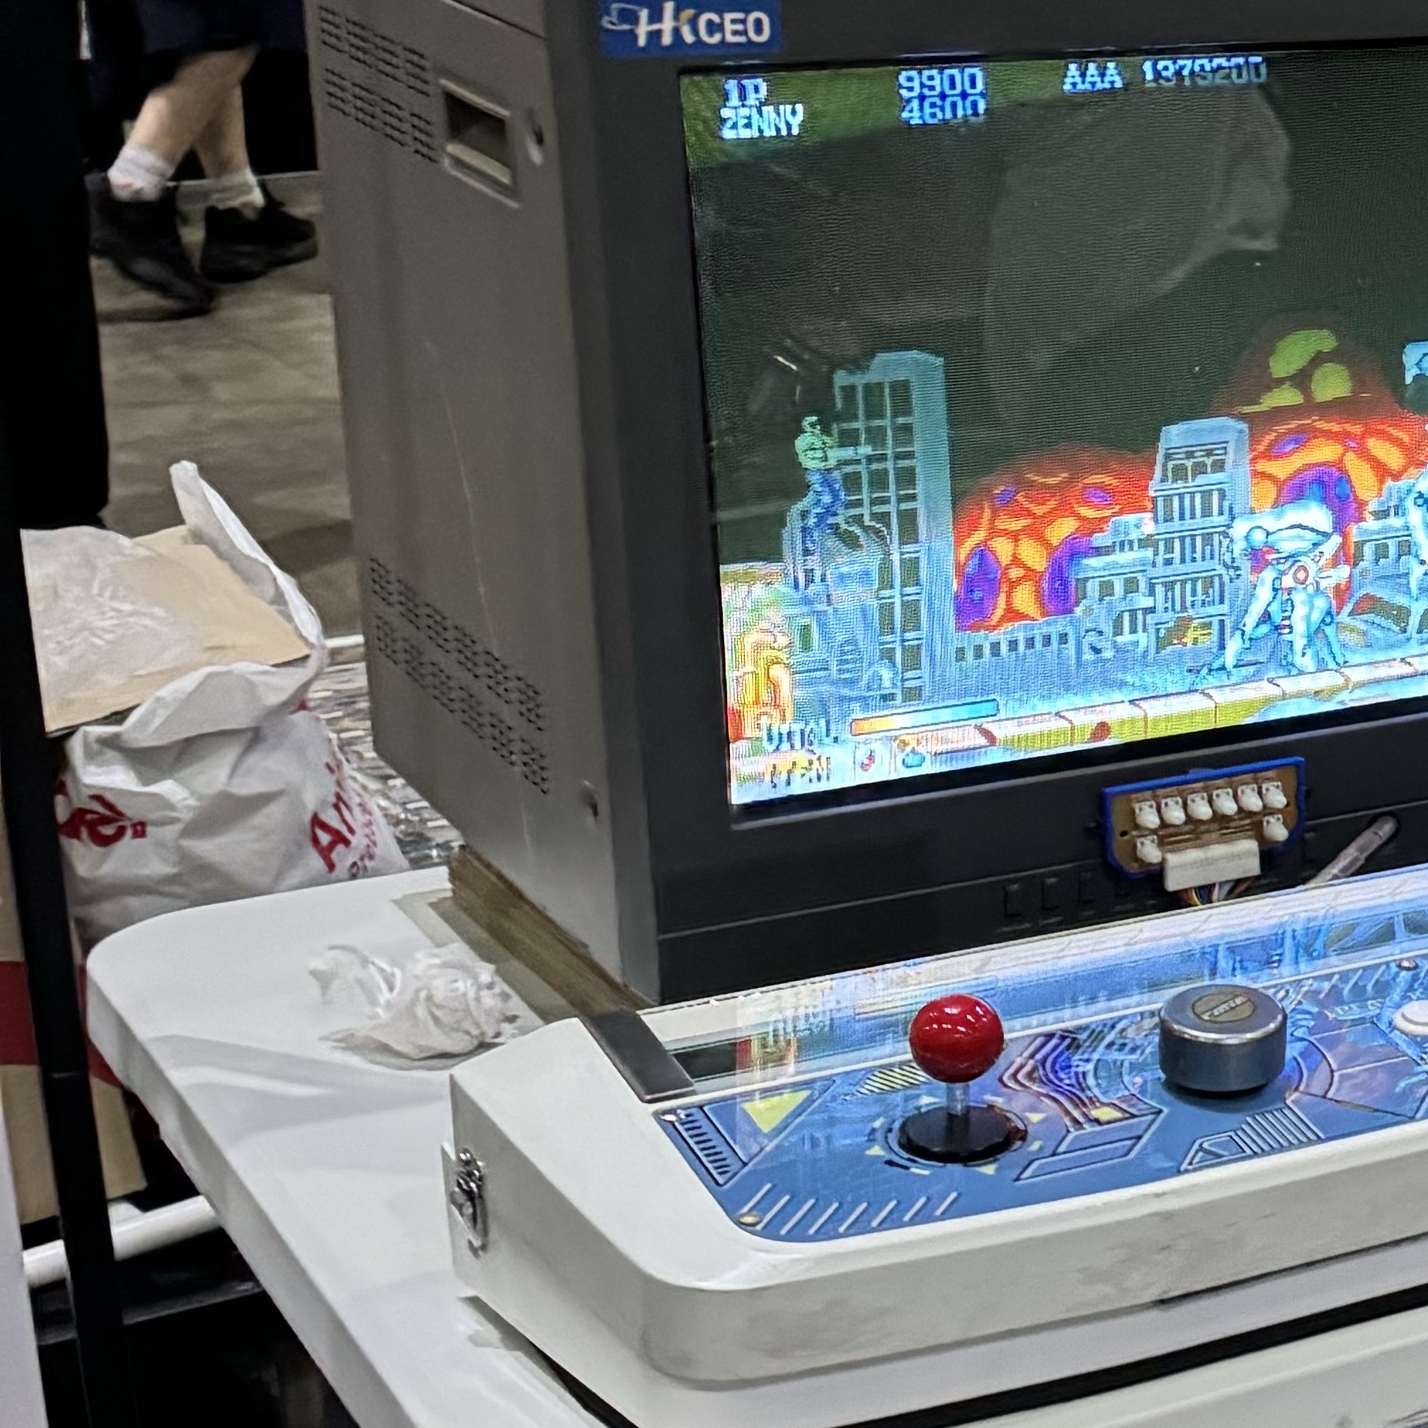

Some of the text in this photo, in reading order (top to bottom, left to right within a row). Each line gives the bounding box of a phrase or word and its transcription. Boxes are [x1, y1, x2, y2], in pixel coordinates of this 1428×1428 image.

[723, 77, 768, 108] 1P
[898, 65, 987, 97] 9900
[1062, 60, 1124, 93] AAA
[719, 95, 987, 139] ZENNY 4600
